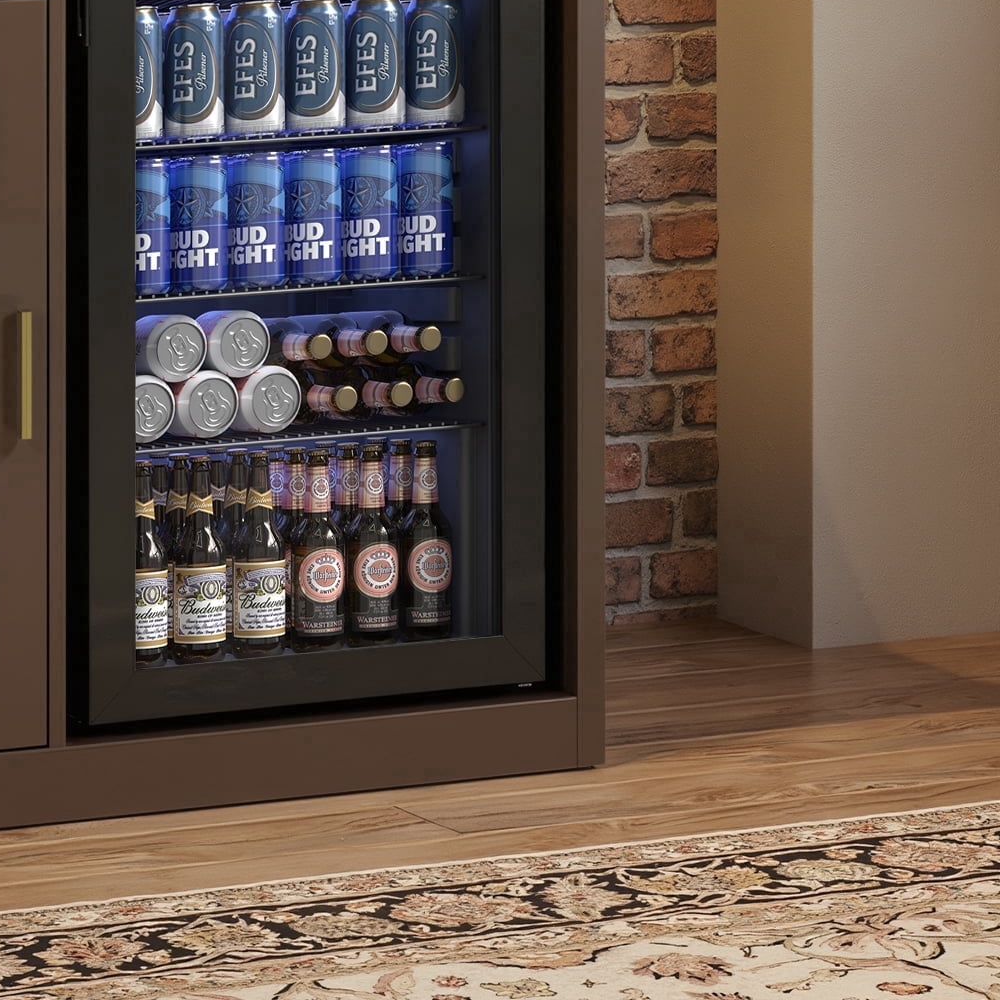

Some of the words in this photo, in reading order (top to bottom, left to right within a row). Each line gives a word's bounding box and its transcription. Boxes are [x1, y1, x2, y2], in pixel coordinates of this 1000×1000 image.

[173, 41, 195, 104] EFES
[234, 38, 256, 100] EFES
[295, 35, 317, 96] EFES
[355, 31, 377, 93] EFES
[415, 28, 438, 90] EFES
[170, 229, 210, 250] BUD
[228, 226, 267, 247] BUD
[285, 222, 324, 243] BUD
[342, 218, 381, 238] BUD
[398, 214, 437, 235] BUD
